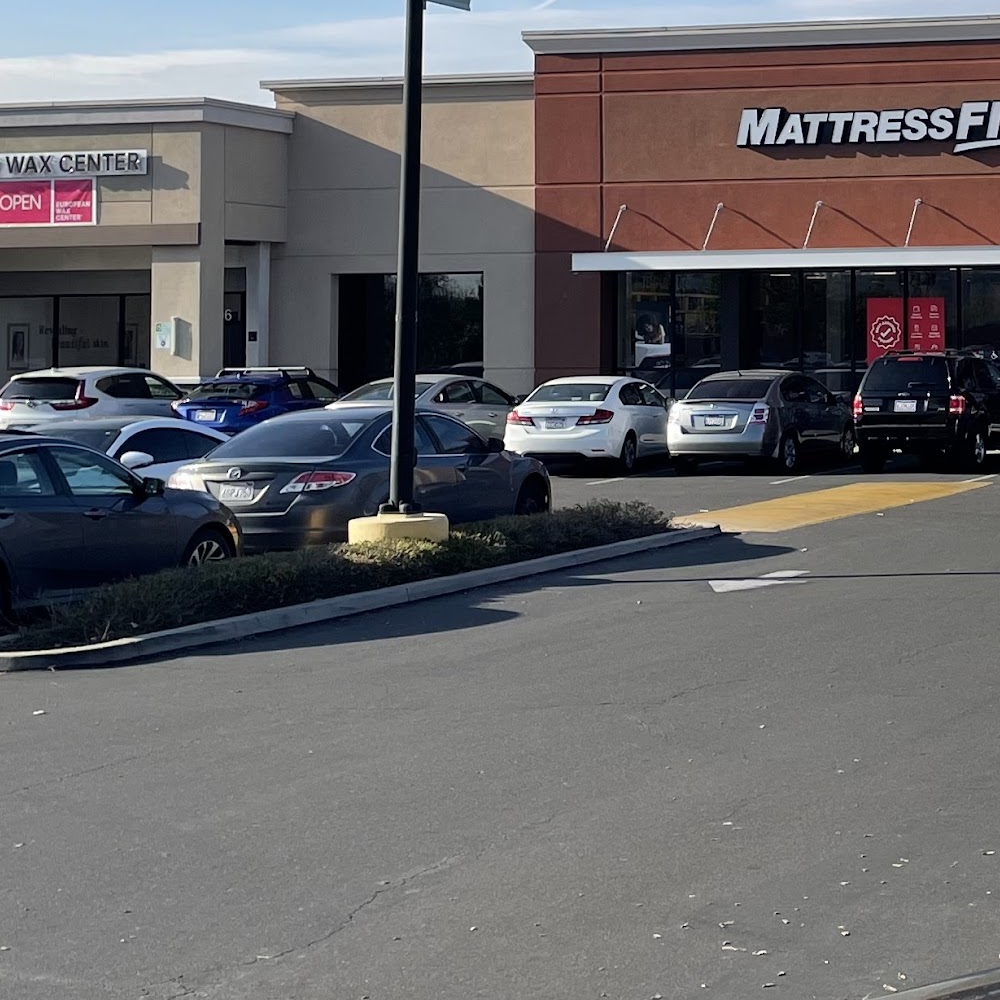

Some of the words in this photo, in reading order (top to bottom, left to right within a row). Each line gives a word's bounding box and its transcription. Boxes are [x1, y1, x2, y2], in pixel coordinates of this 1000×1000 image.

[5, 155, 52, 174] WAX
[59, 152, 140, 174] CENTER
[0, 194, 42, 212] OPEN
